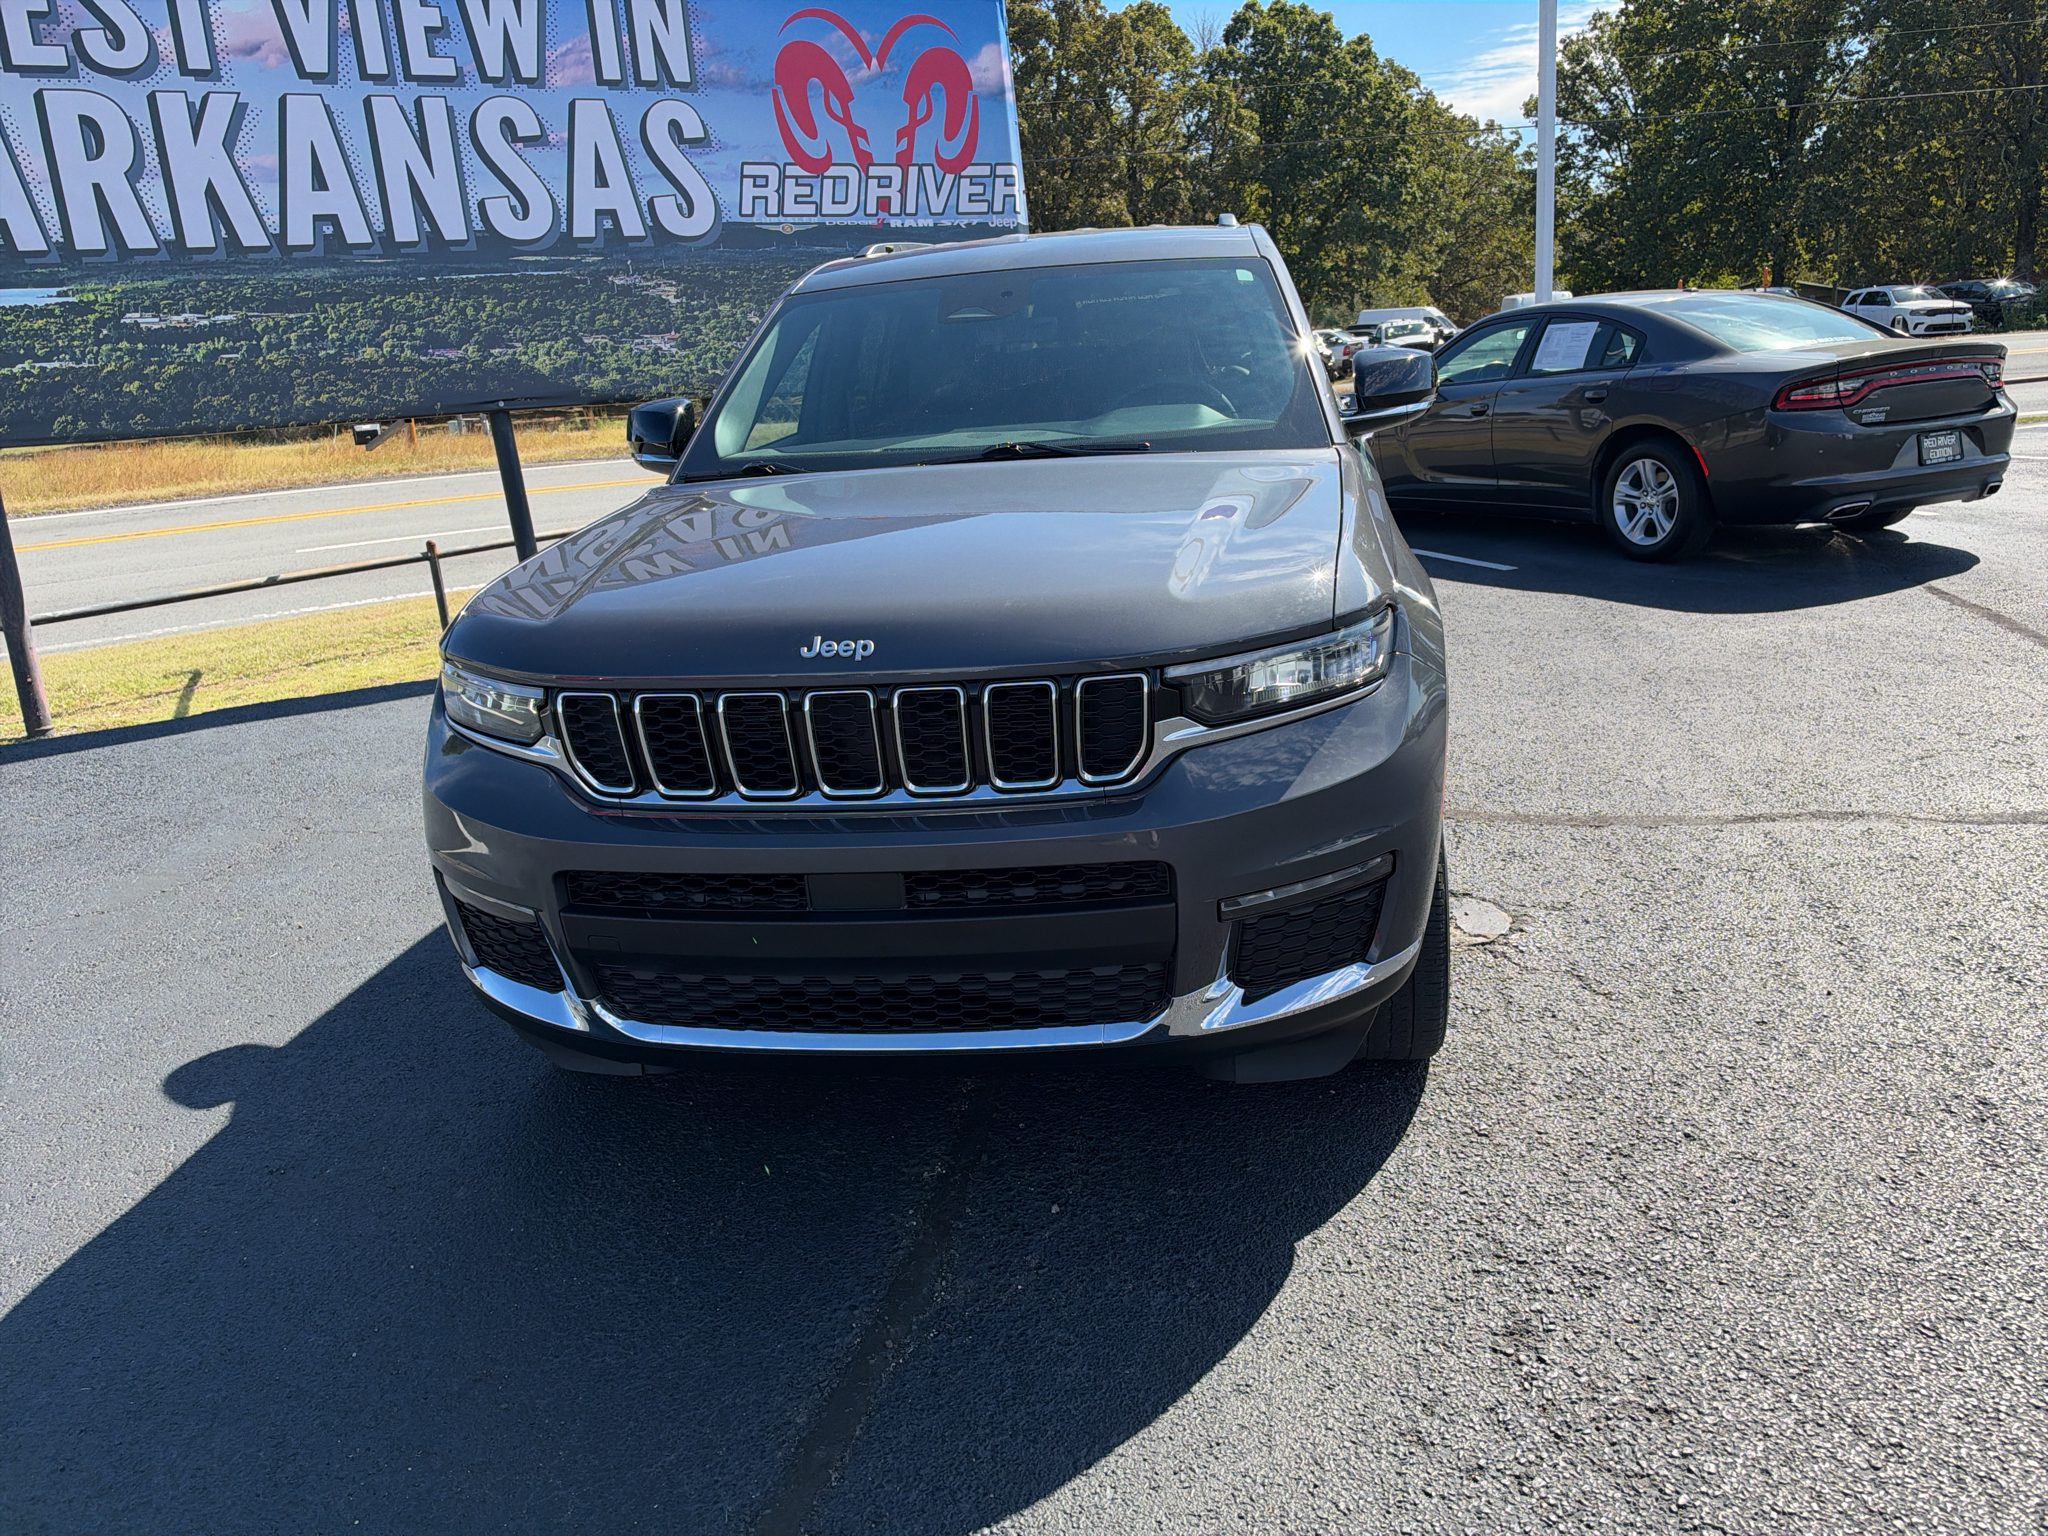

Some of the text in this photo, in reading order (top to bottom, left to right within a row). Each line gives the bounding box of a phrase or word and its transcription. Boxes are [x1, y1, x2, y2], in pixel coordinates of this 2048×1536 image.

[272, 0, 542, 81] VIEW
[586, 0, 693, 87] IN
[889, 218, 934, 228] RAM
[937, 219, 983, 229] SRT
[988, 215, 1018, 229] Jeep
[1923, 435, 1956, 449] RED RIVER
[1929, 447, 1953, 459] EDITION
[800, 635, 875, 662] Jeep
